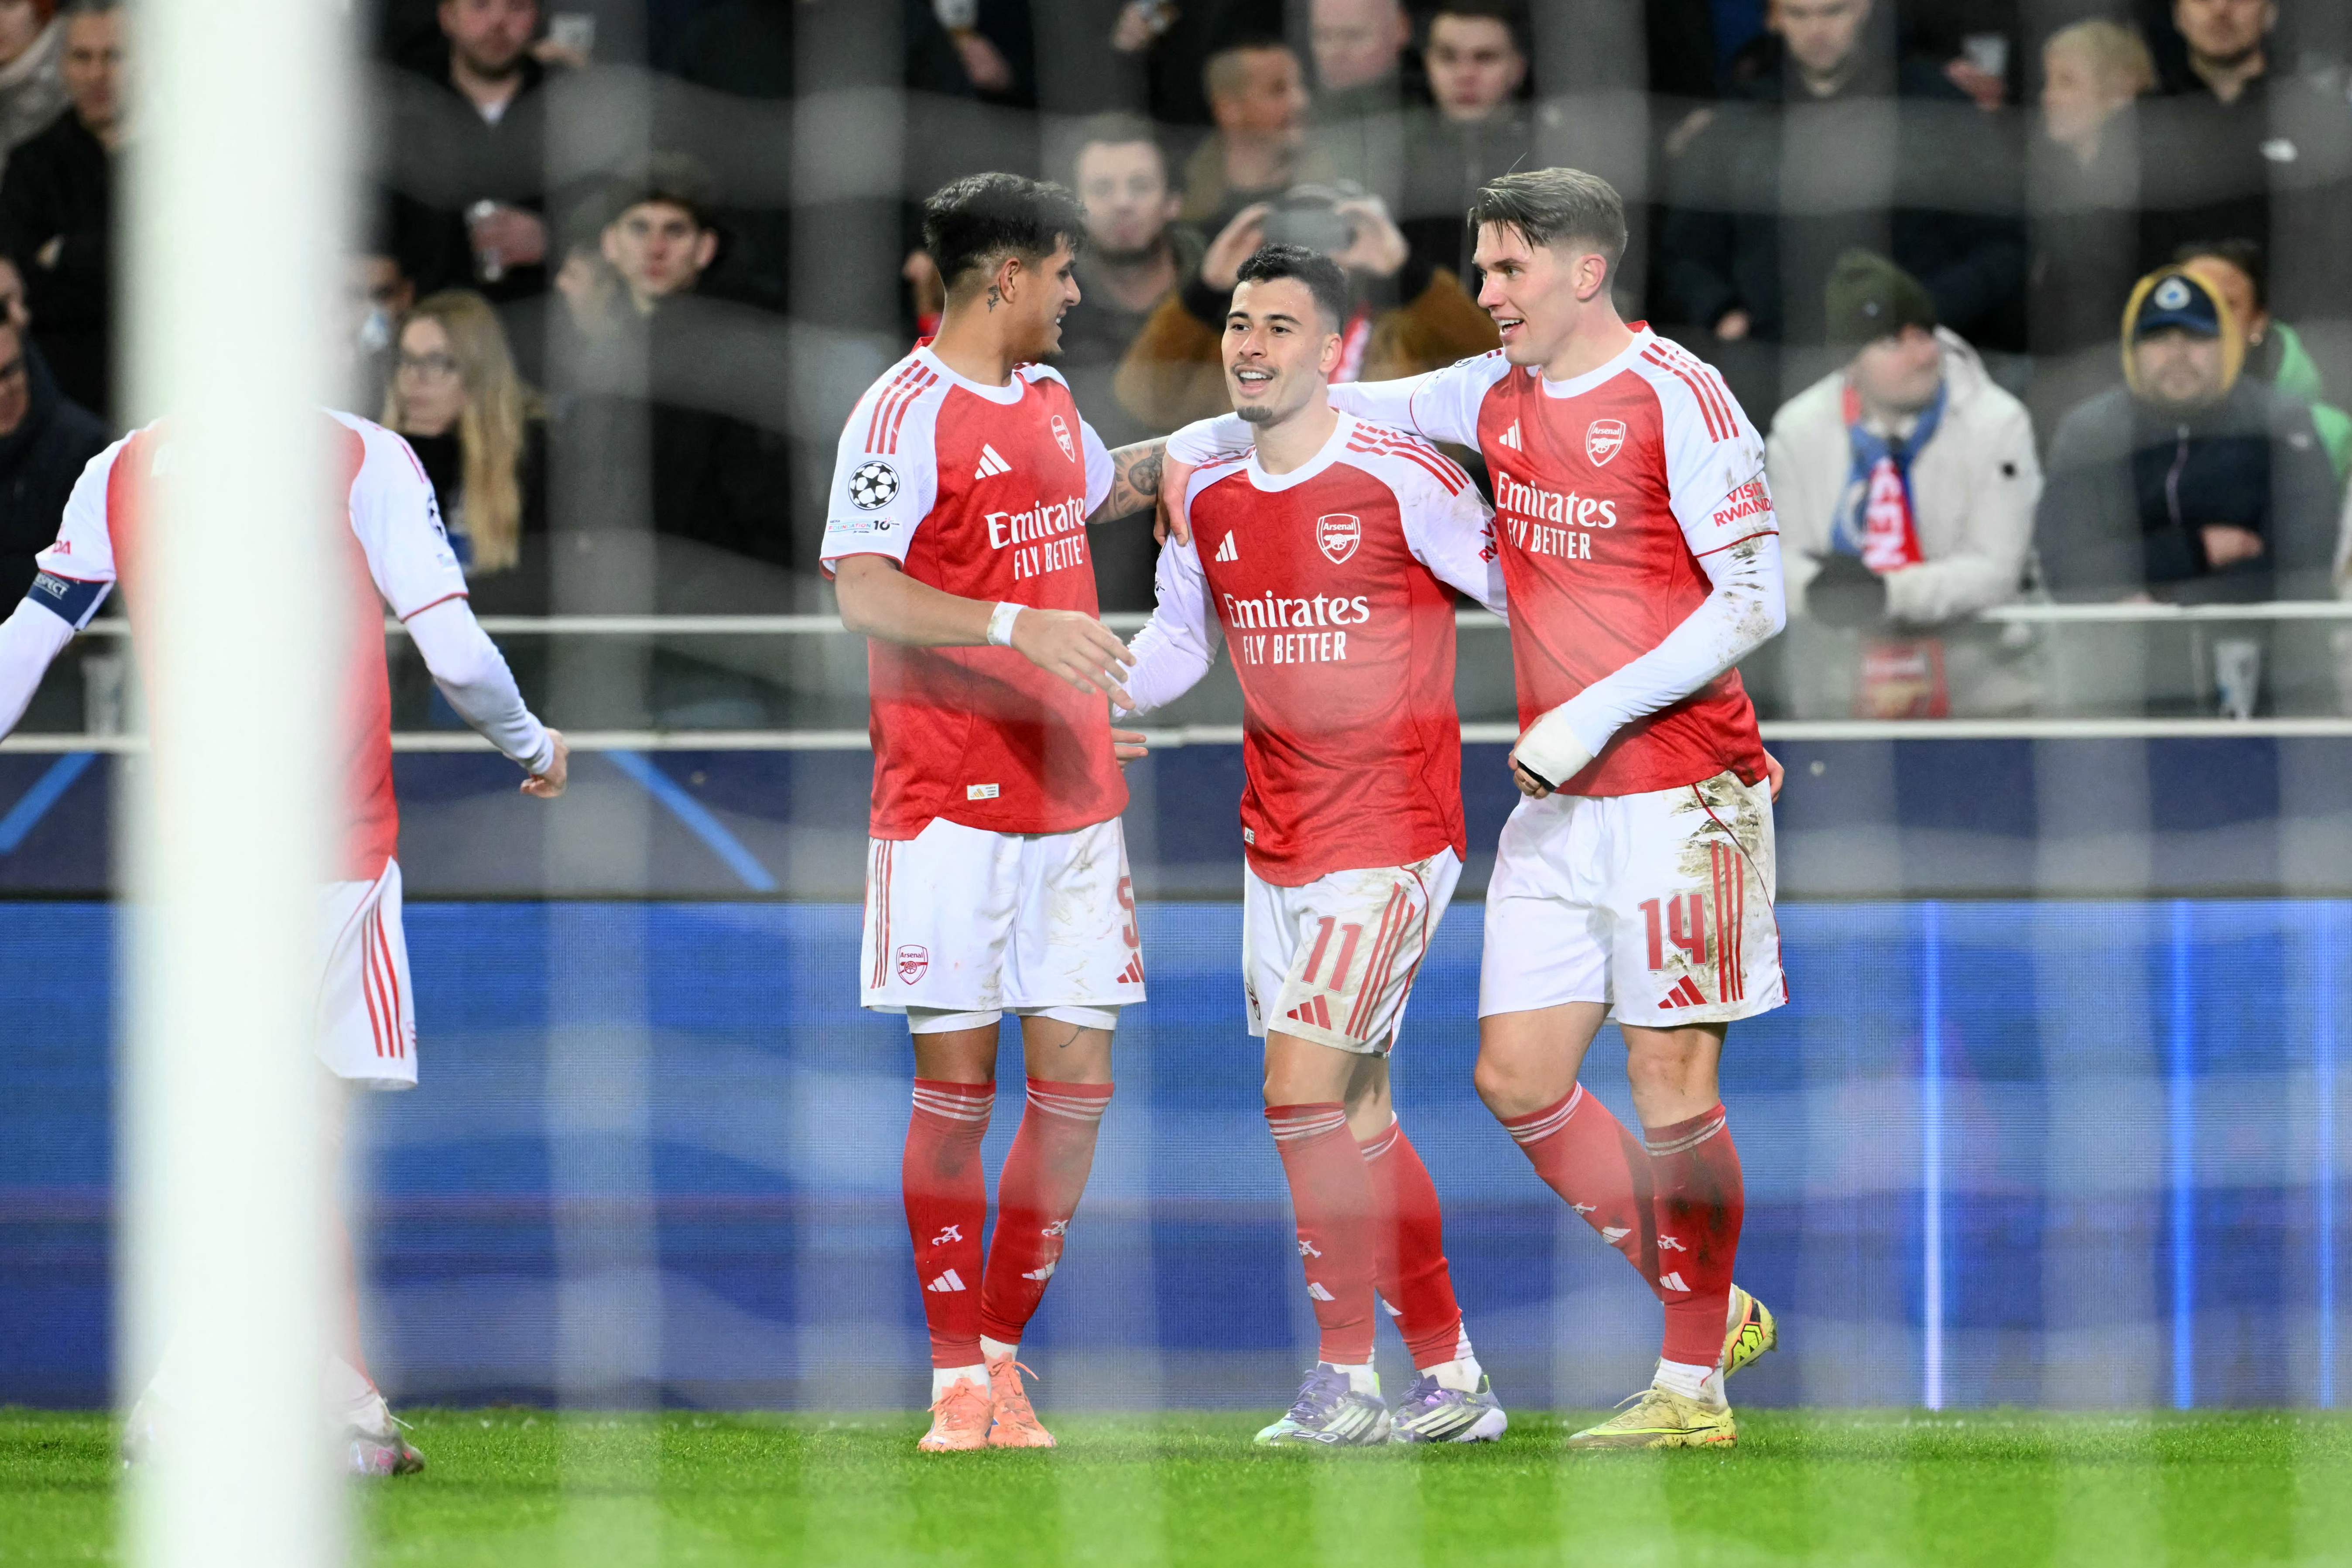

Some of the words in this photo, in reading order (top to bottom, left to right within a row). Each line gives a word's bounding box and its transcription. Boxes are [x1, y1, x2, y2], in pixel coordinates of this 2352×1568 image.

[1592, 427, 1620, 435] Arsenal
[1496, 471, 1616, 528] Emirates
[1726, 482, 1765, 503] VISIT
[828, 523, 871, 531] FOUNDATION
[1323, 522, 1354, 531] Arsenal
[1712, 497, 1774, 527] RWAND
[1507, 517, 1528, 549] FLY
[1530, 523, 1592, 560] BETTER
[1014, 546, 1040, 580] FLY
[1223, 590, 1370, 629] Emirates
[1243, 635, 1266, 665] FLY
[1273, 631, 1346, 664] BETTER
[1637, 892, 1708, 971] 14
[1301, 915, 1363, 993] 11
